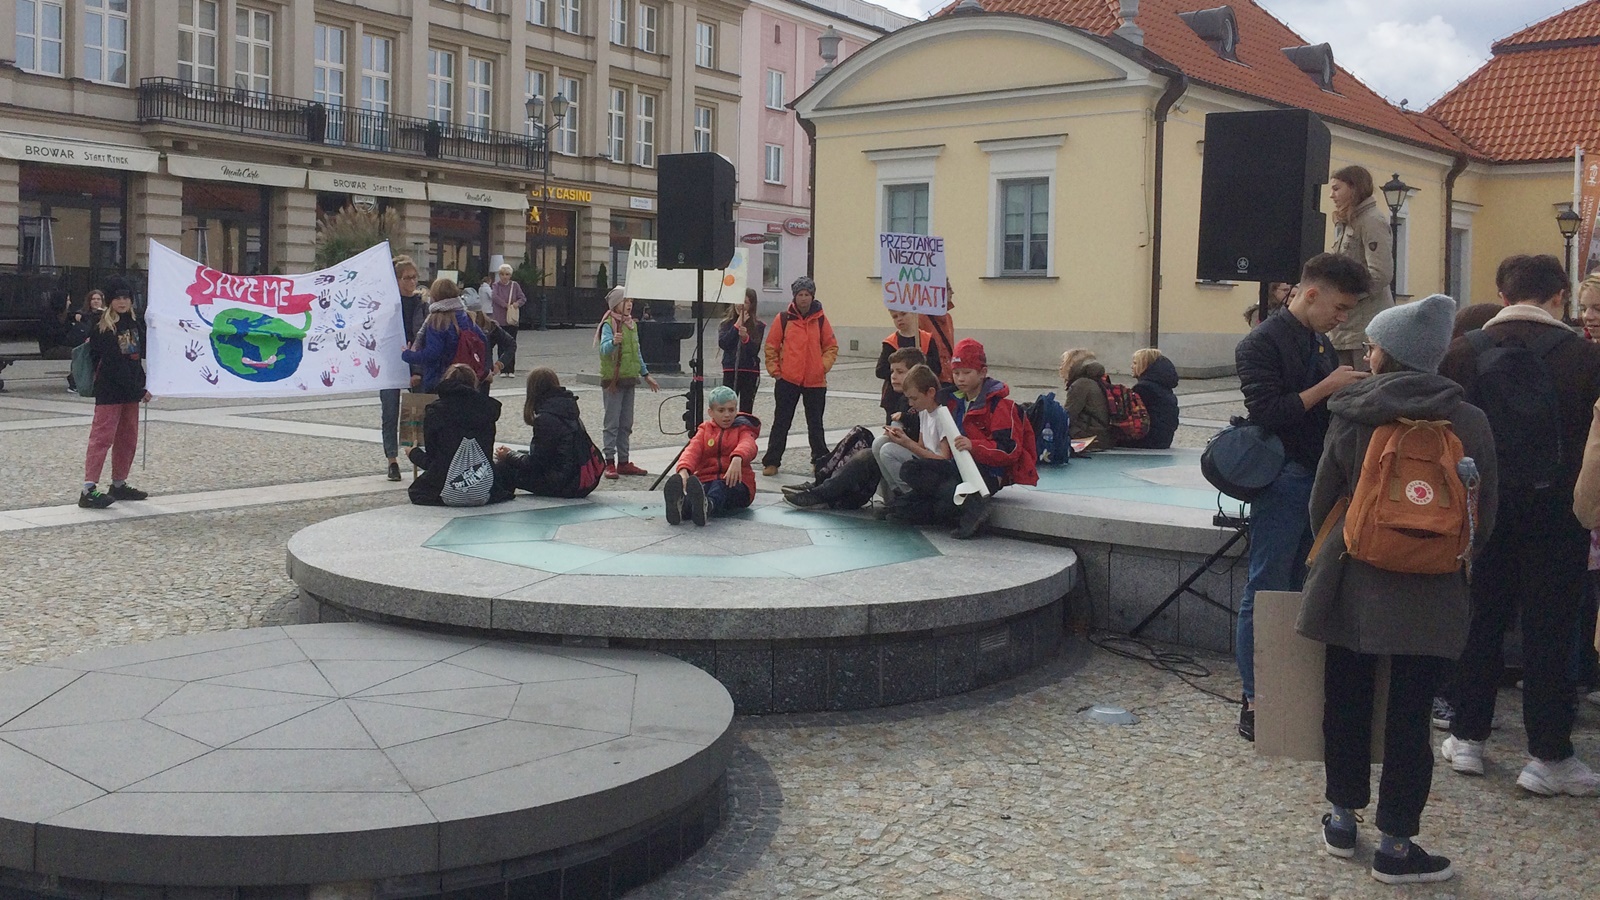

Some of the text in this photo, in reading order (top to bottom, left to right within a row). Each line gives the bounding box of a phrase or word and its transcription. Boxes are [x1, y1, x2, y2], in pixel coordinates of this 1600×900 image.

[25, 145, 75, 160] BROWAR
[333, 179, 367, 190] BROWAR
[556, 188, 592, 202] CASINO
[888, 248, 937, 267] NISZCZYĆ
[200, 268, 291, 307] SAVE ME
[885, 278, 946, 308] ŚWIAT!
